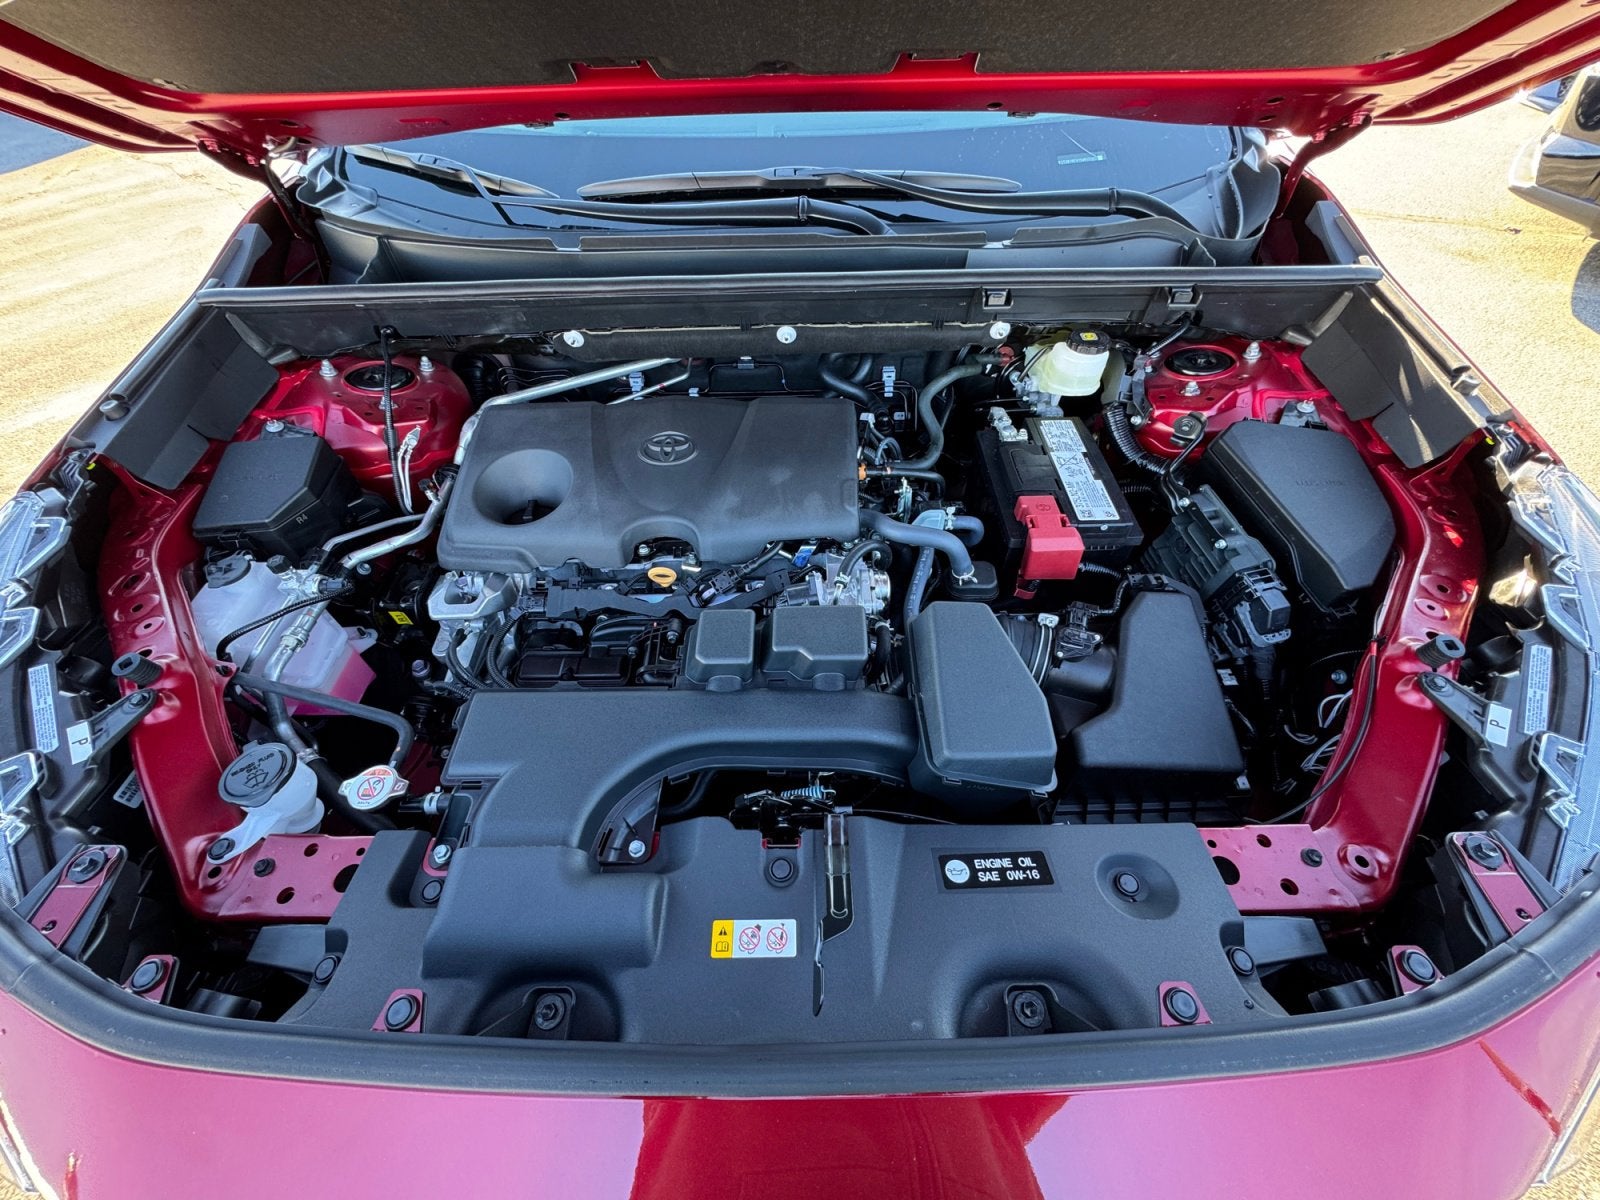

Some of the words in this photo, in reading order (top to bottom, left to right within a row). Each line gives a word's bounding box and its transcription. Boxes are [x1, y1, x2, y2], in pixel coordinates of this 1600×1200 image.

[295, 513, 308, 525] R4
[1489, 719, 1506, 730] P
[72, 737, 89, 746] P
[974, 858, 1013, 869] ENGINE
[1018, 857, 1037, 867] OIL
[978, 871, 1001, 882] SAE
[1006, 869, 1040, 880] 0W-16
